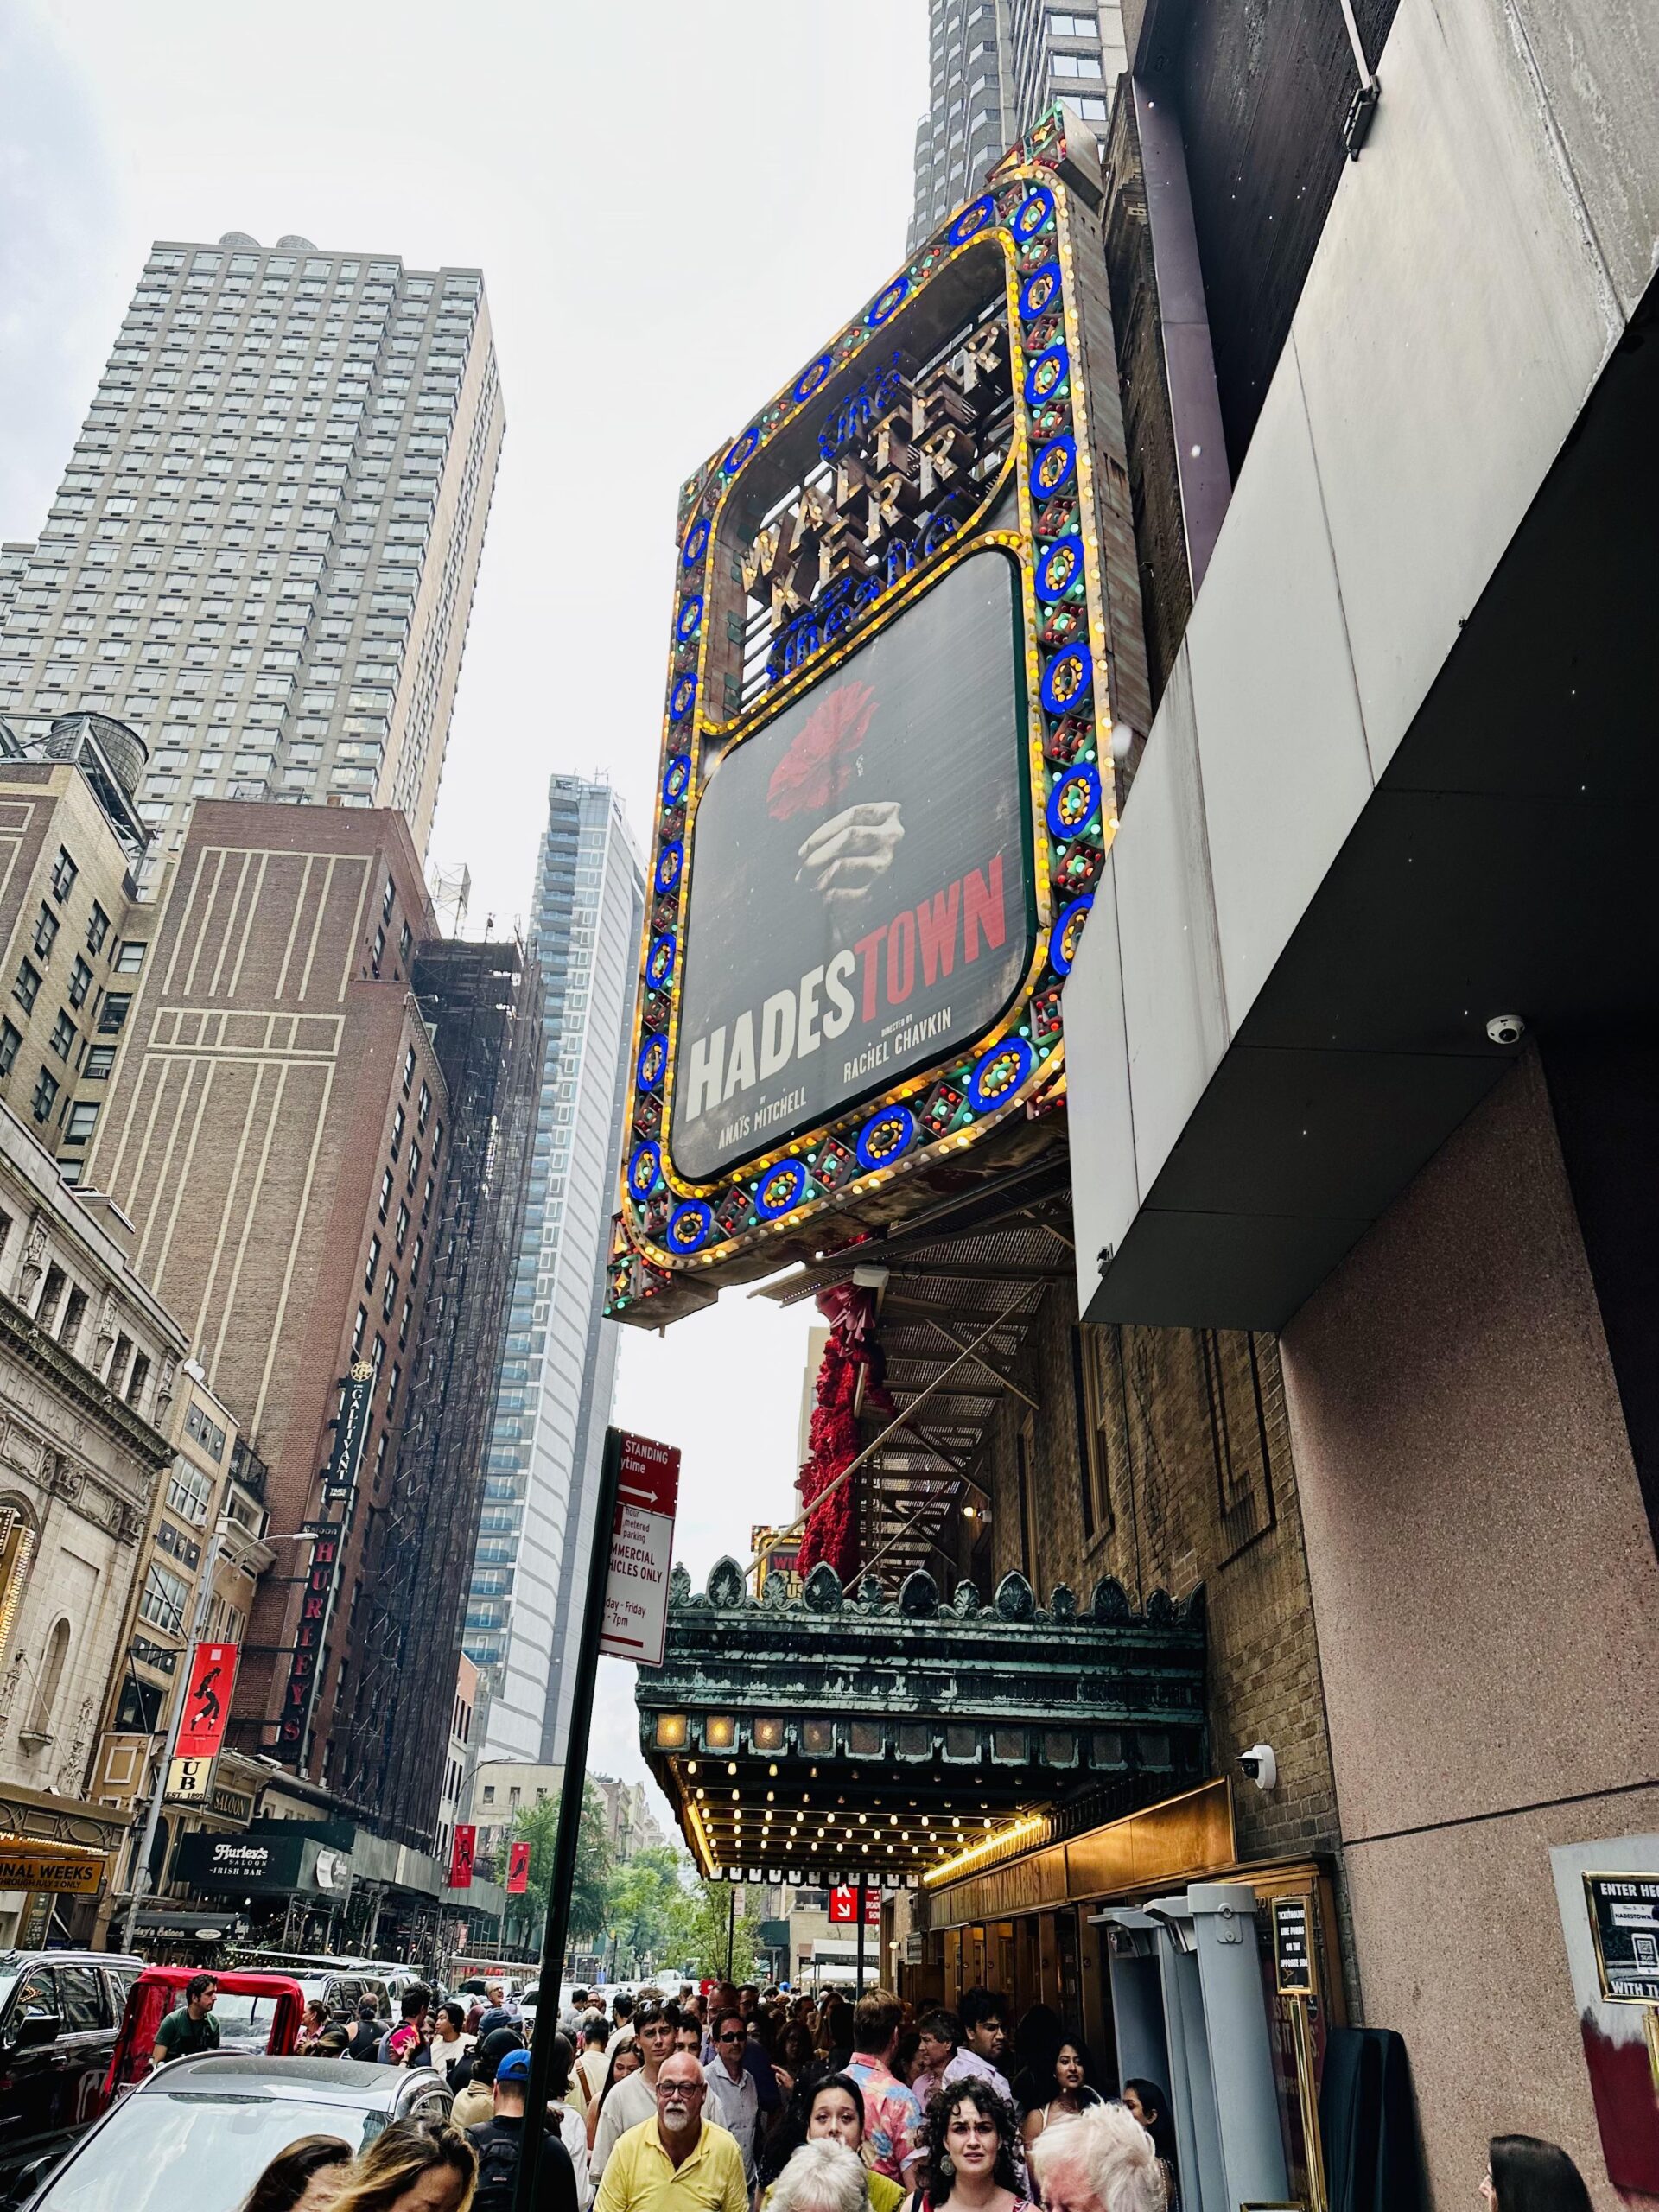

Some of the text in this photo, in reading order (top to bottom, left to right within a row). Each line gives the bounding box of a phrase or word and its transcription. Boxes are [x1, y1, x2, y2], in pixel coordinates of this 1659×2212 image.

[741, 321, 1002, 596] WALTER
[771, 422, 959, 638] KERR
[685, 855, 1006, 1122] HADESTOWN
[880, 1013, 913, 1038] DIRECTED BY
[843, 1007, 951, 1083] RACHEL CHAVKIN
[718, 1086, 807, 1150] ANAÏS MITCHELL
[336, 1389, 365, 1481] GALLIVANT
[625, 1440, 669, 1465] STANDING
[623, 1529, 646, 1544] parking
[625, 1518, 650, 1533] metered
[611, 1542, 655, 1566] MMERCIAL
[609, 1558, 663, 1584] HICLES ONLY
[605, 1597, 620, 1612] day
[625, 1601, 646, 1618] Friday
[613, 1612, 628, 1627] 7pm
[177, 1757, 201, 1790] UB
[215, 1791, 245, 1817] SALOON
[213, 1844, 268, 1861] Hurley's
[40, 1865, 93, 1881] WEEKS
[1600, 1882, 1637, 1897] ENTER
[1611, 1980, 1644, 1996] WITH
